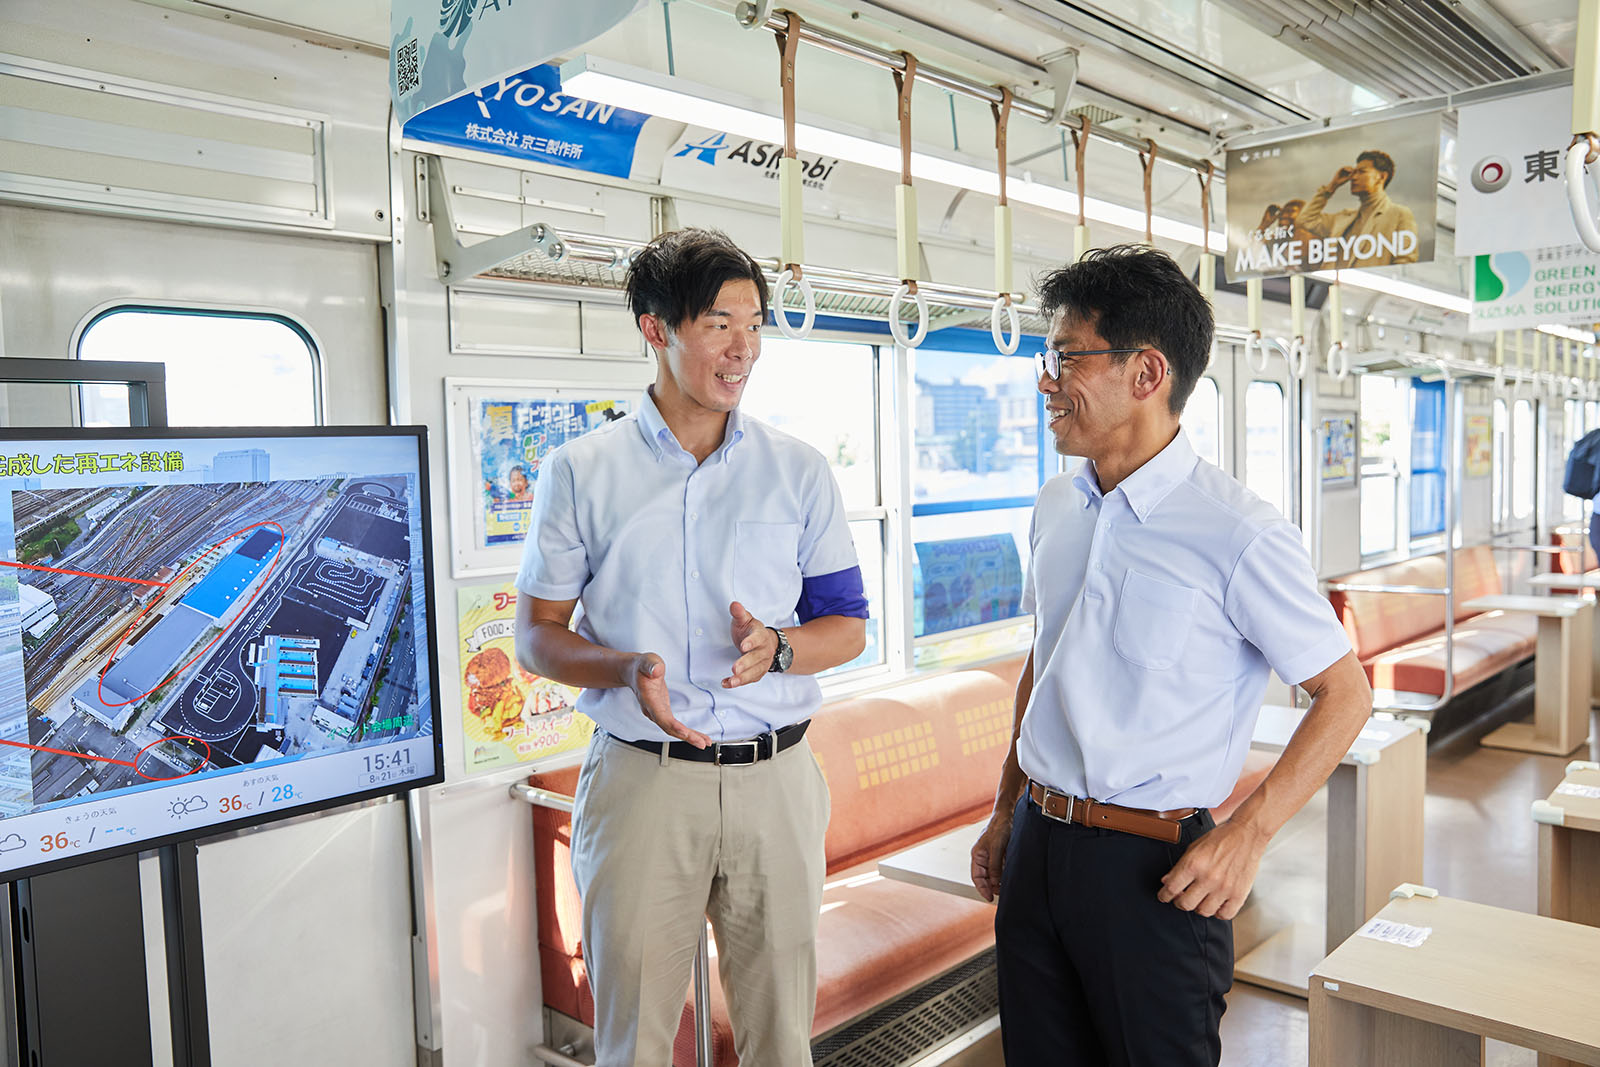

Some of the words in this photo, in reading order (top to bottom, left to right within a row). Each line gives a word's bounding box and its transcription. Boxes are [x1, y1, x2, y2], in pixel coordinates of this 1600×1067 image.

[465, 122, 519, 147] 株式会社
[519, 133, 584, 160] 京三製作所
[1234, 240, 1303, 273] MAKE
[1308, 230, 1417, 264] BEYOND
[1534, 265, 1596, 283] GREEN
[363, 748, 411, 772] 15:41
[242, 773, 280, 788] あすの天気
[64, 807, 118, 824] きょうの天気
